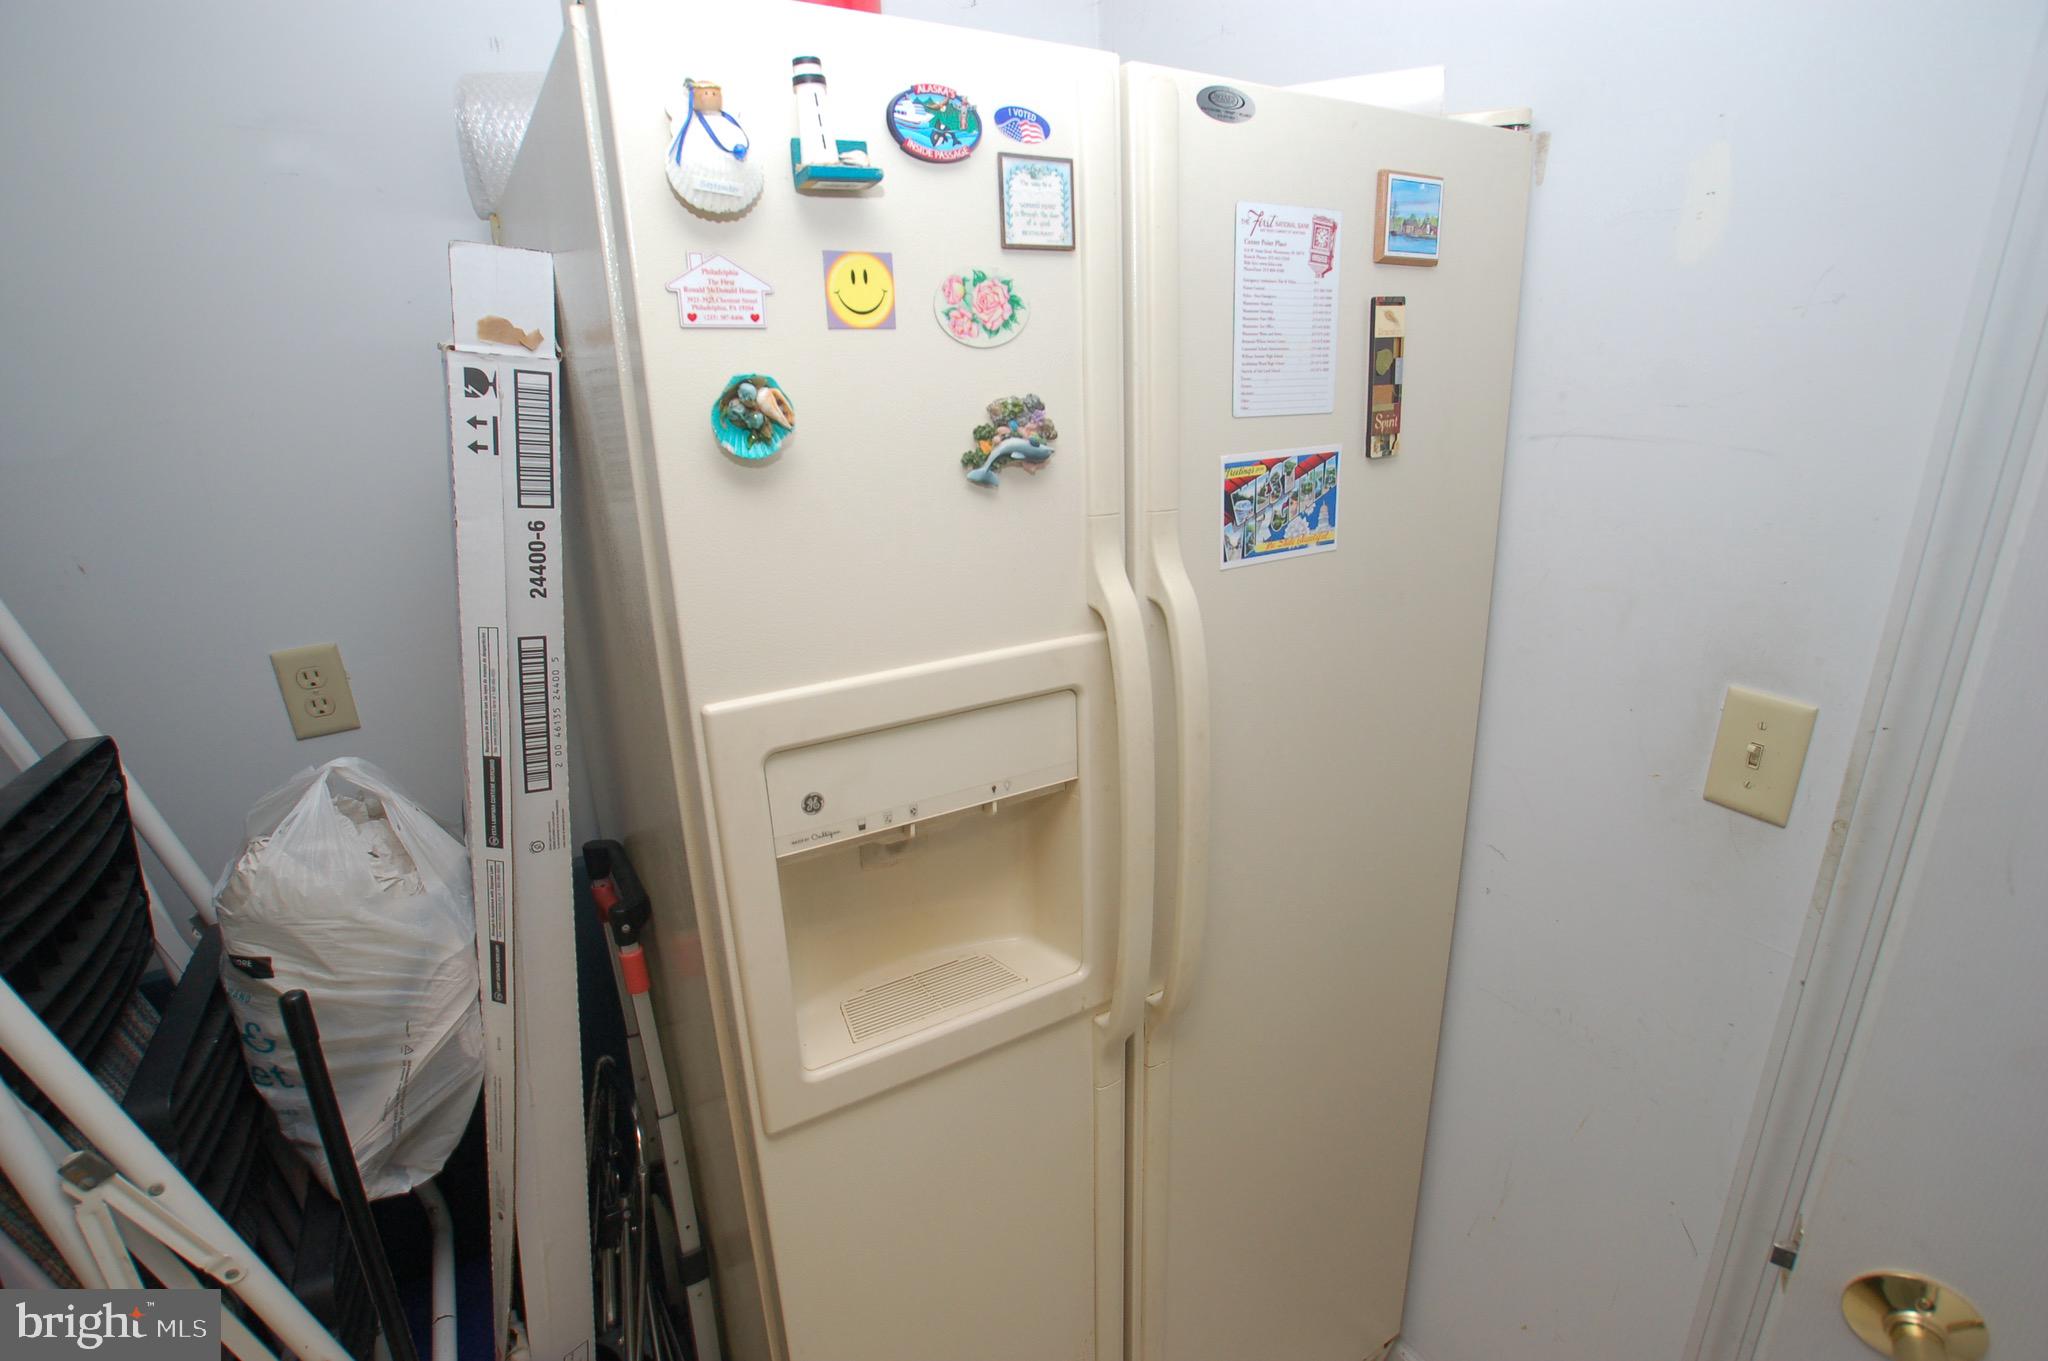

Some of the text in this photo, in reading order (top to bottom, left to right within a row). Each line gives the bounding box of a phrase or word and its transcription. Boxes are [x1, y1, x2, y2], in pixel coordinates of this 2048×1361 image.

[917, 84, 955, 99] ALASKA'S
[1013, 109, 1037, 122] VOTED
[906, 139, 970, 161] INSIDE PASSAGE
[1375, 412, 1399, 432] Spirit
[528, 520, 548, 599] 24400-6
[551, 669, 560, 701] 24400
[552, 707, 561, 738] 46135
[554, 744, 562, 757] 00
